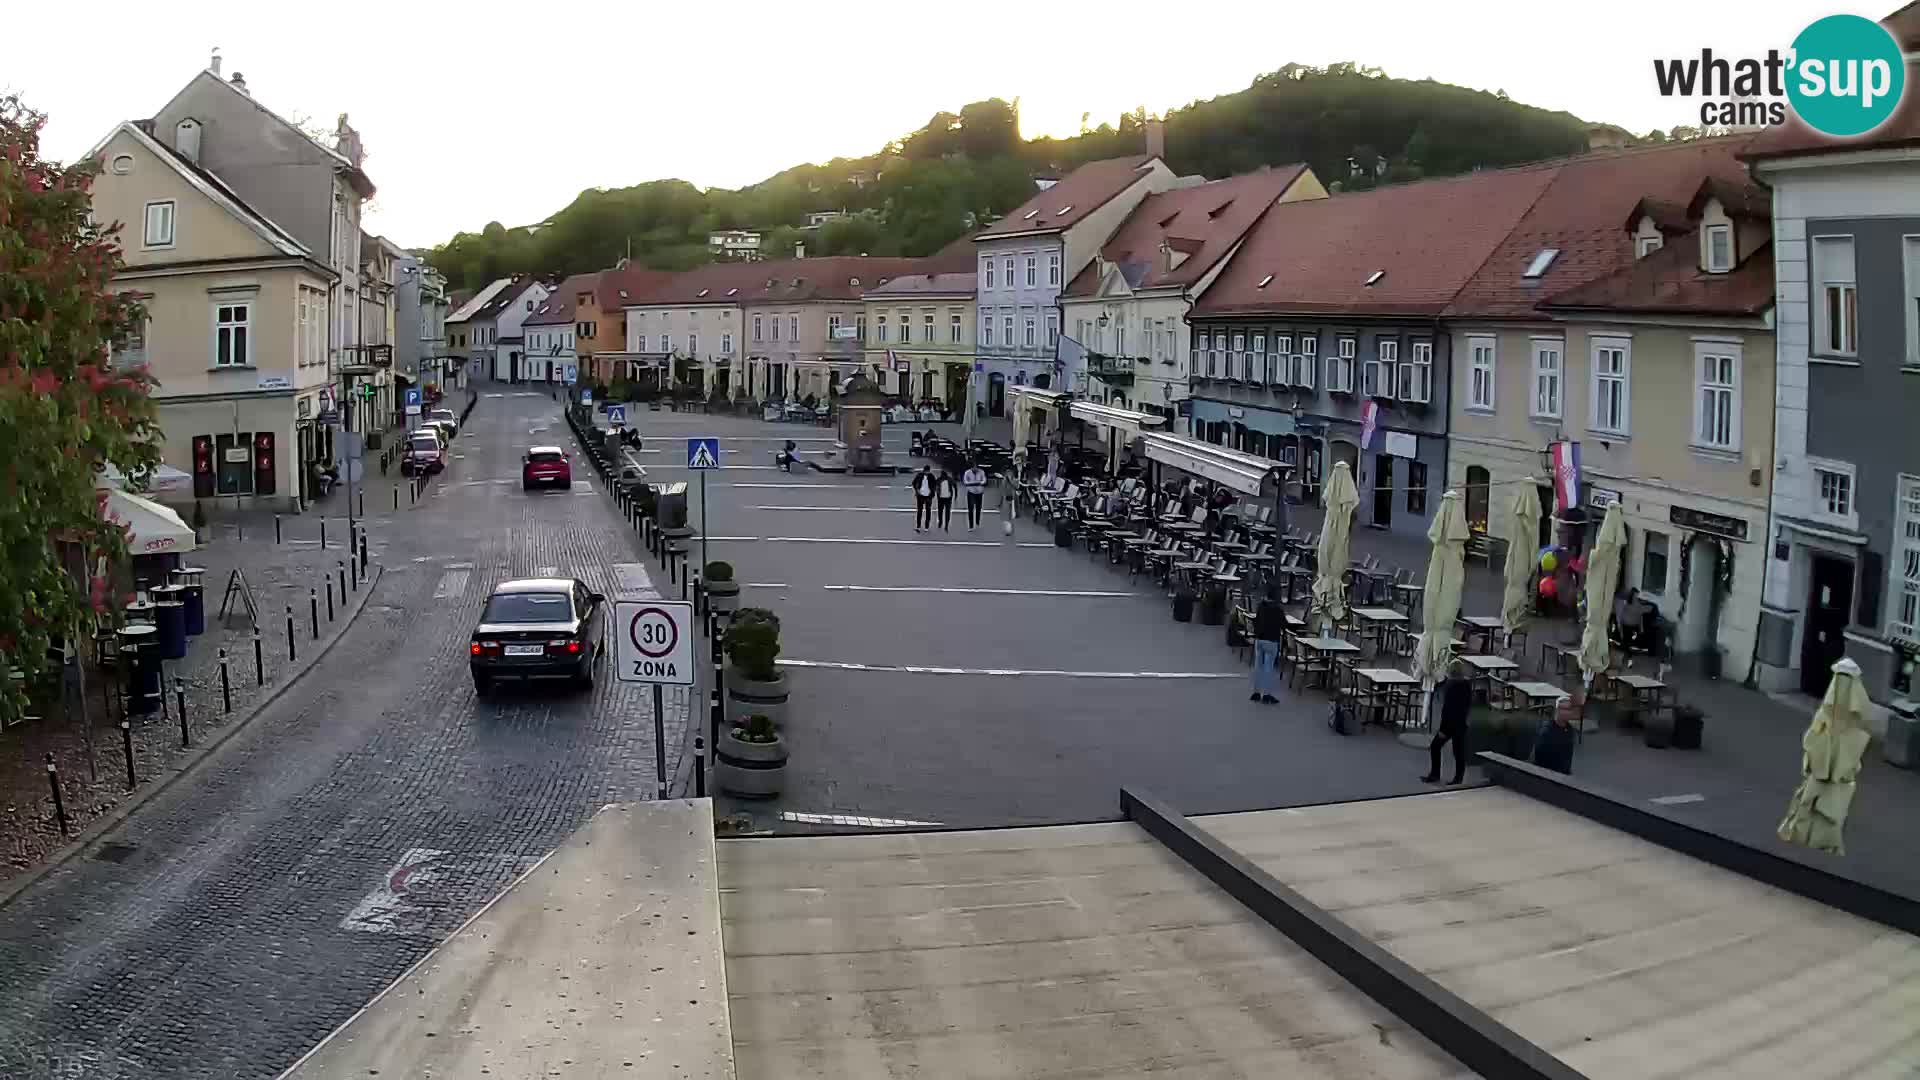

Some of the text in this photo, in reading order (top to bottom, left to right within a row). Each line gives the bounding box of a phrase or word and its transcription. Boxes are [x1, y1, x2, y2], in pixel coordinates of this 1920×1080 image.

[409, 392, 417, 404] P
[643, 623, 667, 645] 30
[633, 660, 677, 677] ZONA
